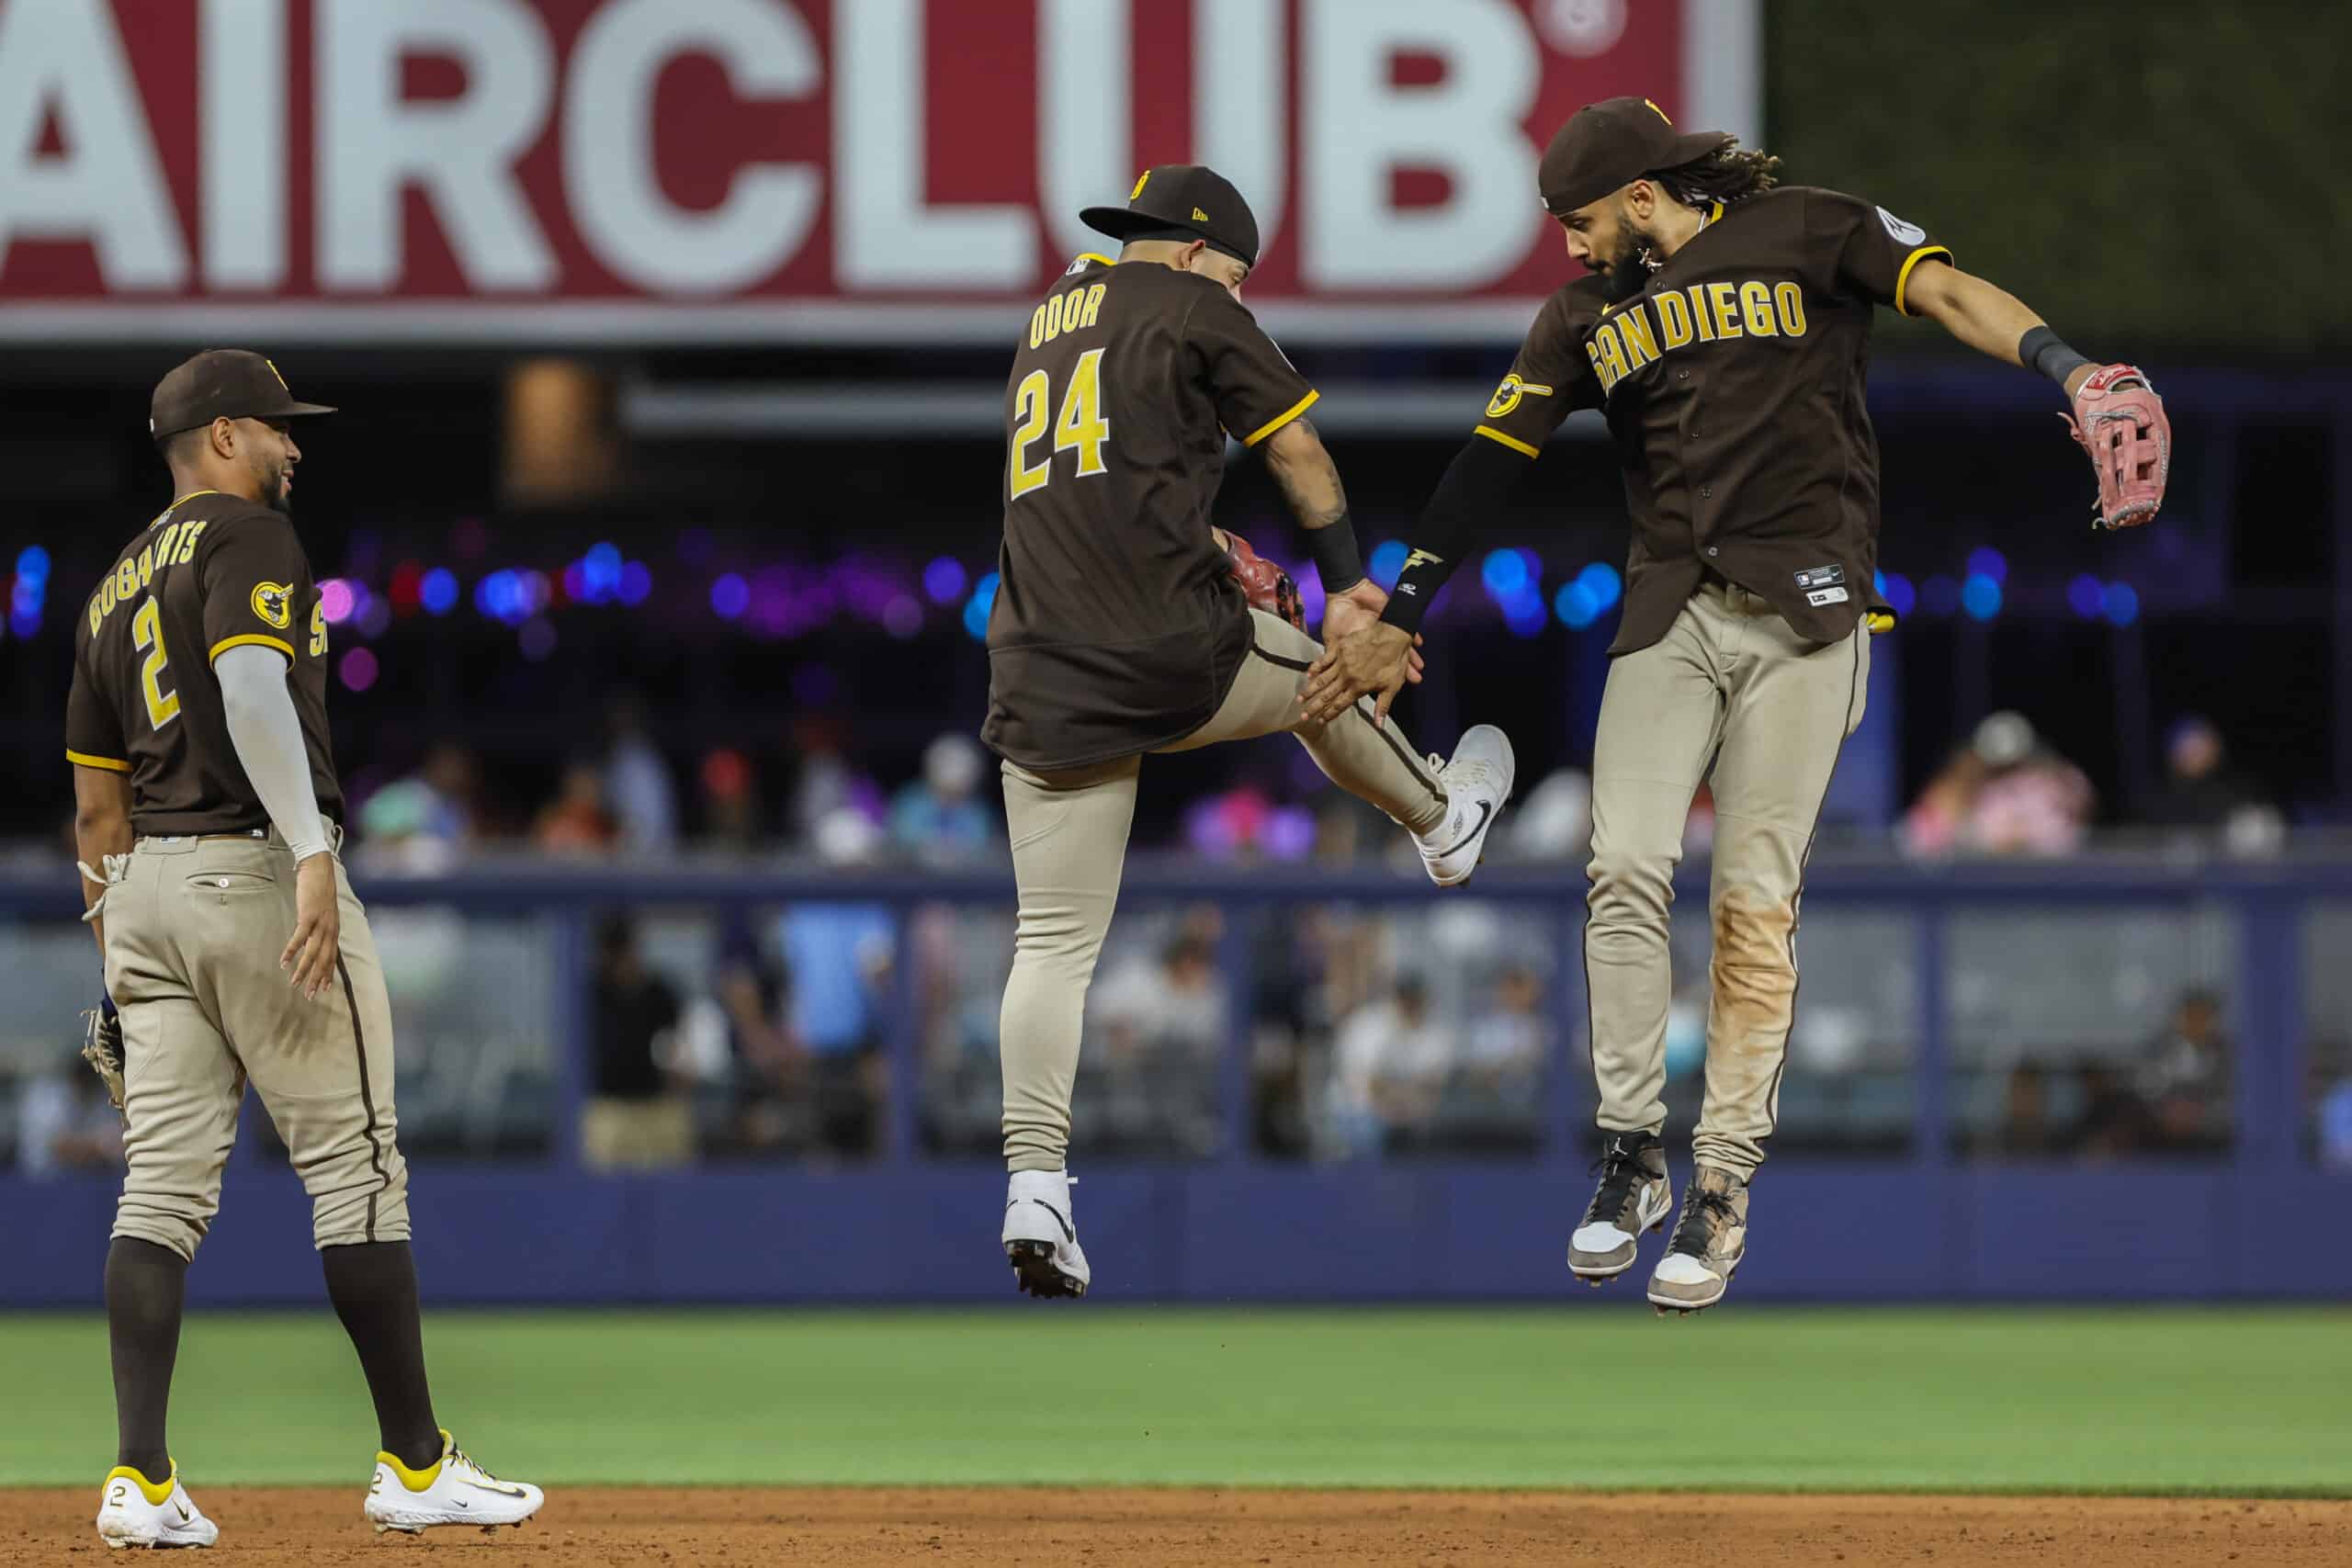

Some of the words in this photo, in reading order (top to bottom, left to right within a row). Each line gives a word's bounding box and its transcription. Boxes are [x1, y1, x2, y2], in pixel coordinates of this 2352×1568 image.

[1030, 283, 1106, 350] ODOR
[1651, 281, 1807, 351] DIEGO
[1011, 347, 1110, 502] 24
[89, 521, 207, 638] BOGARTS
[132, 594, 181, 731] 2
